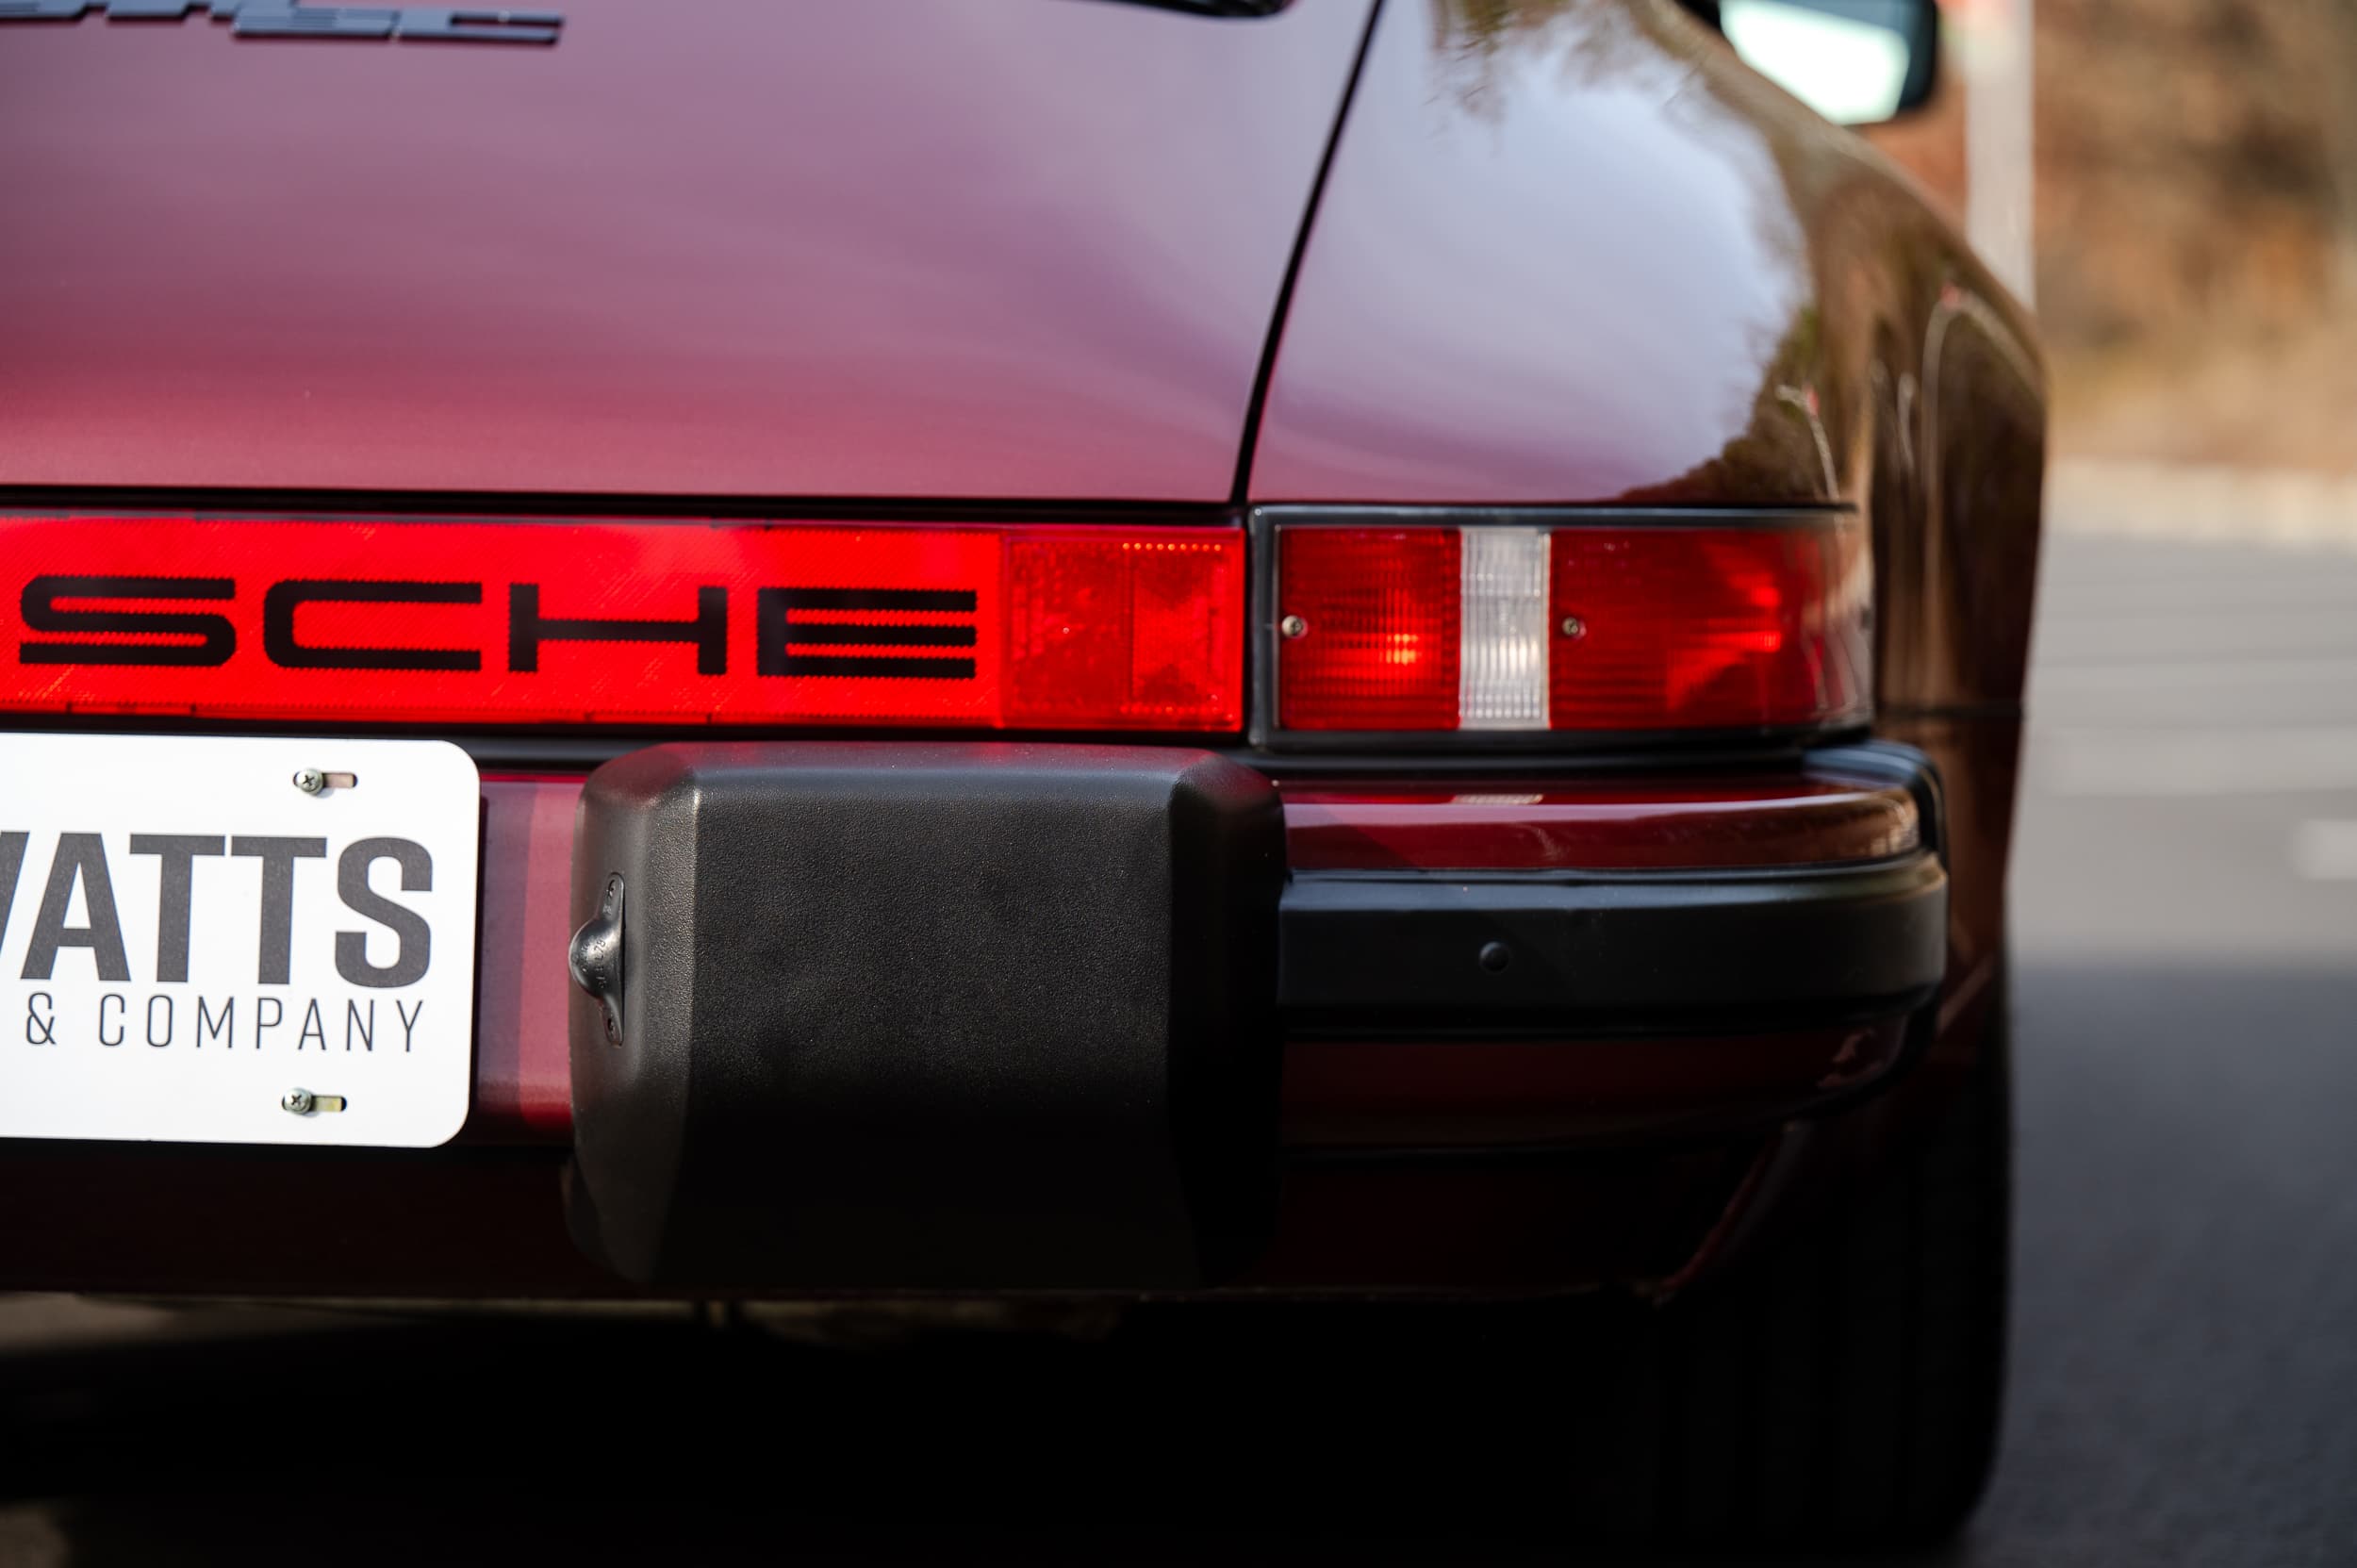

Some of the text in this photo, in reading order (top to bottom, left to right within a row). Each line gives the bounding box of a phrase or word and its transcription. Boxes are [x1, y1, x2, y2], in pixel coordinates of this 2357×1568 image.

[20, 575, 977, 680] SCHE
[0, 831, 433, 989] ATTS
[25, 992, 423, 1053] & COMPANY
